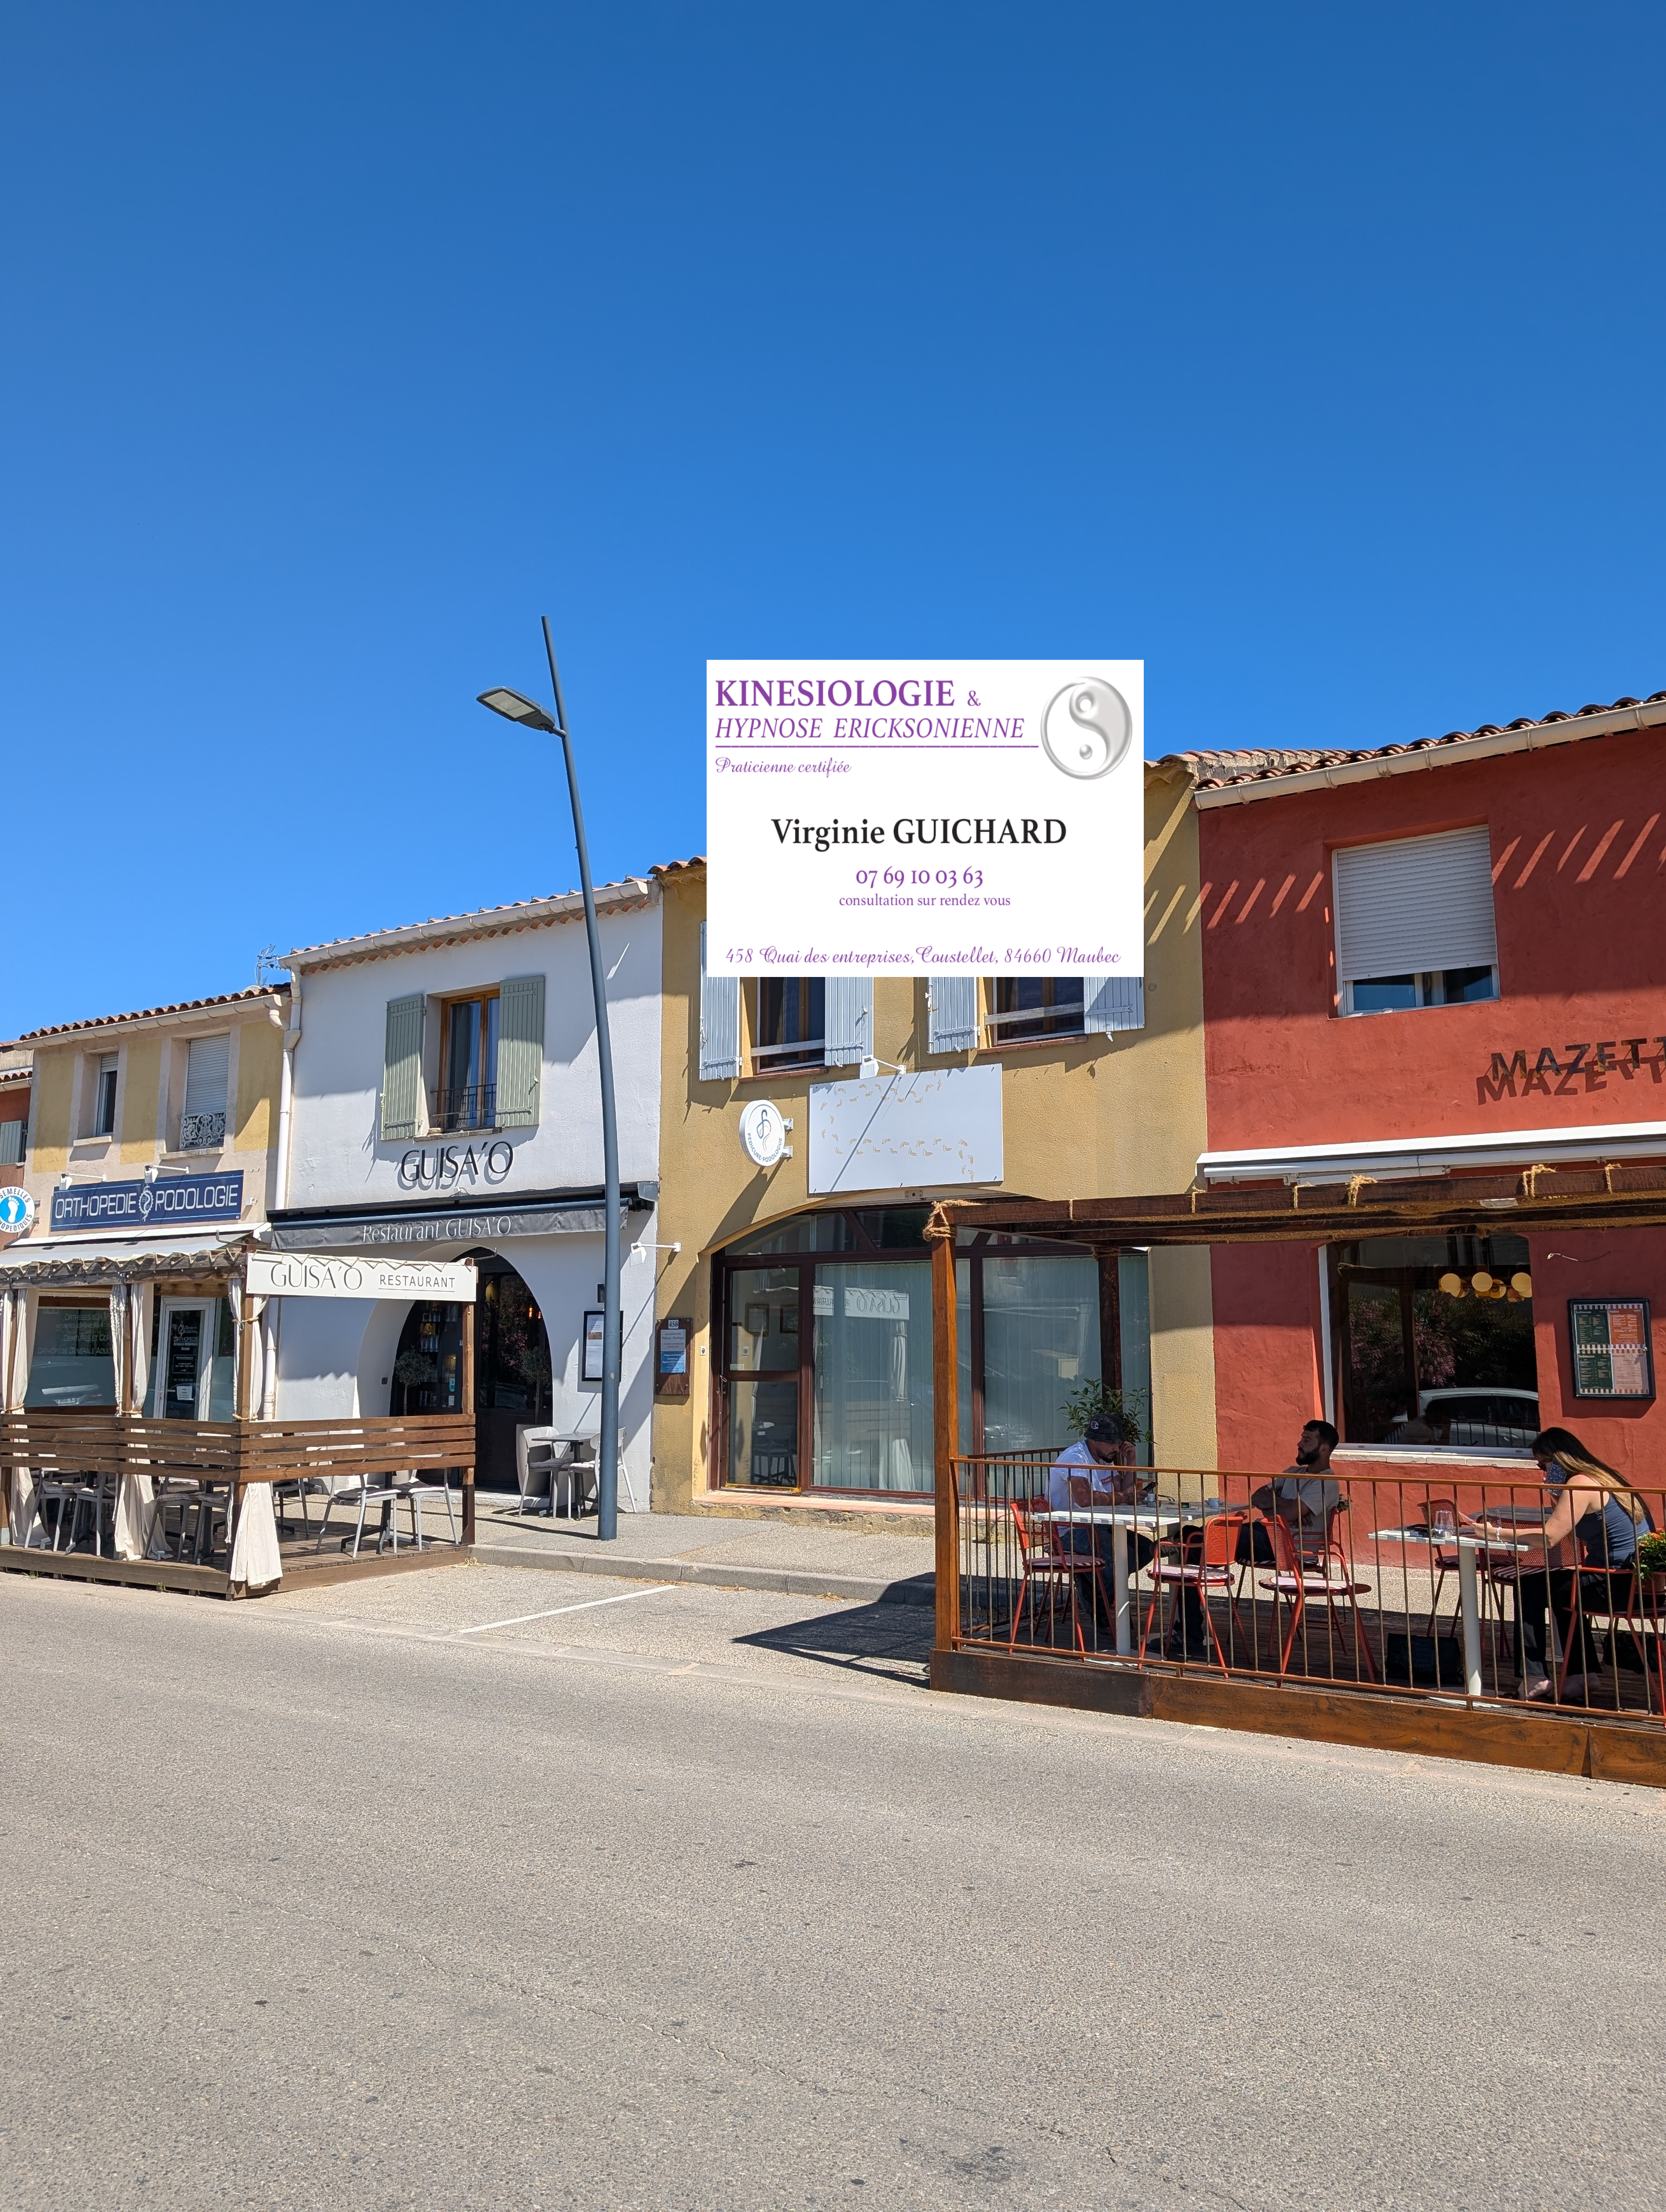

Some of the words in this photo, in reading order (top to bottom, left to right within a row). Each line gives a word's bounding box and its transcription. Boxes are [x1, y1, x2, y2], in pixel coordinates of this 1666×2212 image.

[401, 1141, 514, 1181] GUISA'O
[55, 1192, 137, 1218] ORTHOPEDIE
[155, 1185, 239, 1211] PODOLOGIE
[363, 1221, 440, 1243] Restaurant
[446, 1216, 512, 1237] GUISA'O
[271, 1263, 363, 1290] GUISA'O
[380, 1274, 456, 1288] RESTAURANT
